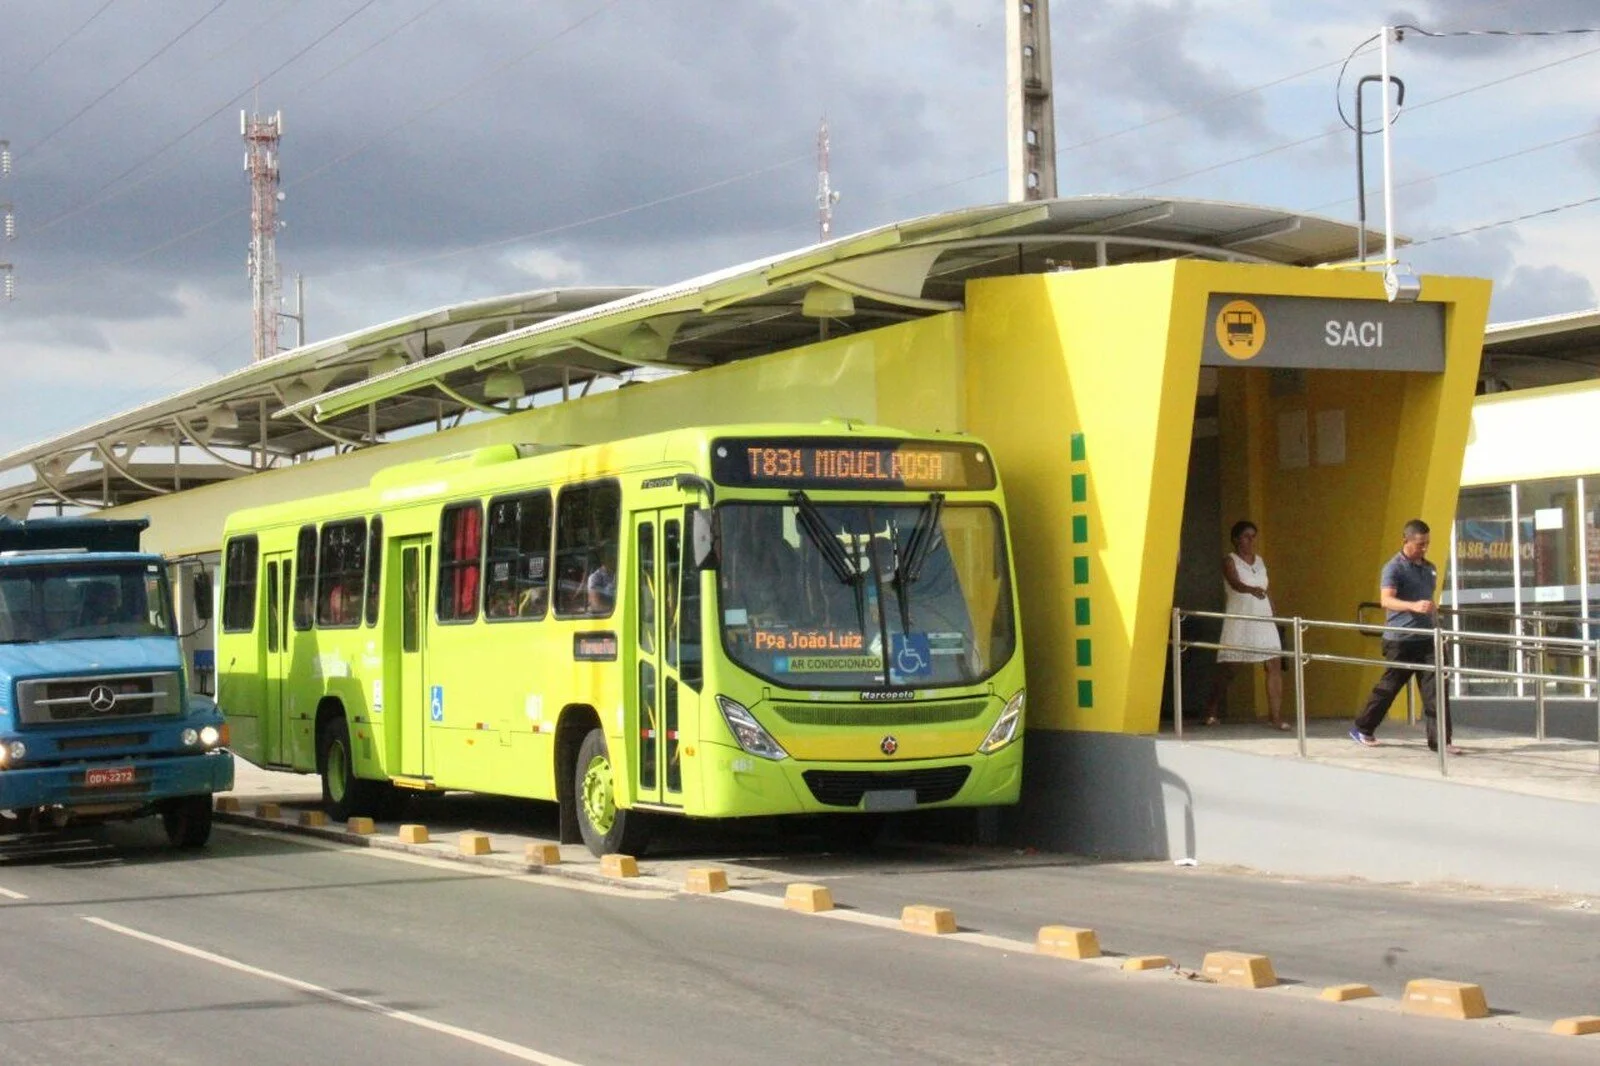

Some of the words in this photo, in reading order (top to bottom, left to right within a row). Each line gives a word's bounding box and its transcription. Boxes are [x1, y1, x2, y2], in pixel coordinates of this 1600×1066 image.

[1324, 320, 1384, 348] SACI
[748, 447, 805, 476] T831
[815, 449, 889, 479] MIGUEL
[892, 452, 943, 480] ROSA
[788, 630, 828, 649] João
[829, 631, 863, 649] Luiz
[790, 660, 805, 670] AR
[807, 656, 880, 670] CONDICIONADO
[861, 691, 914, 701] Marcopolo
